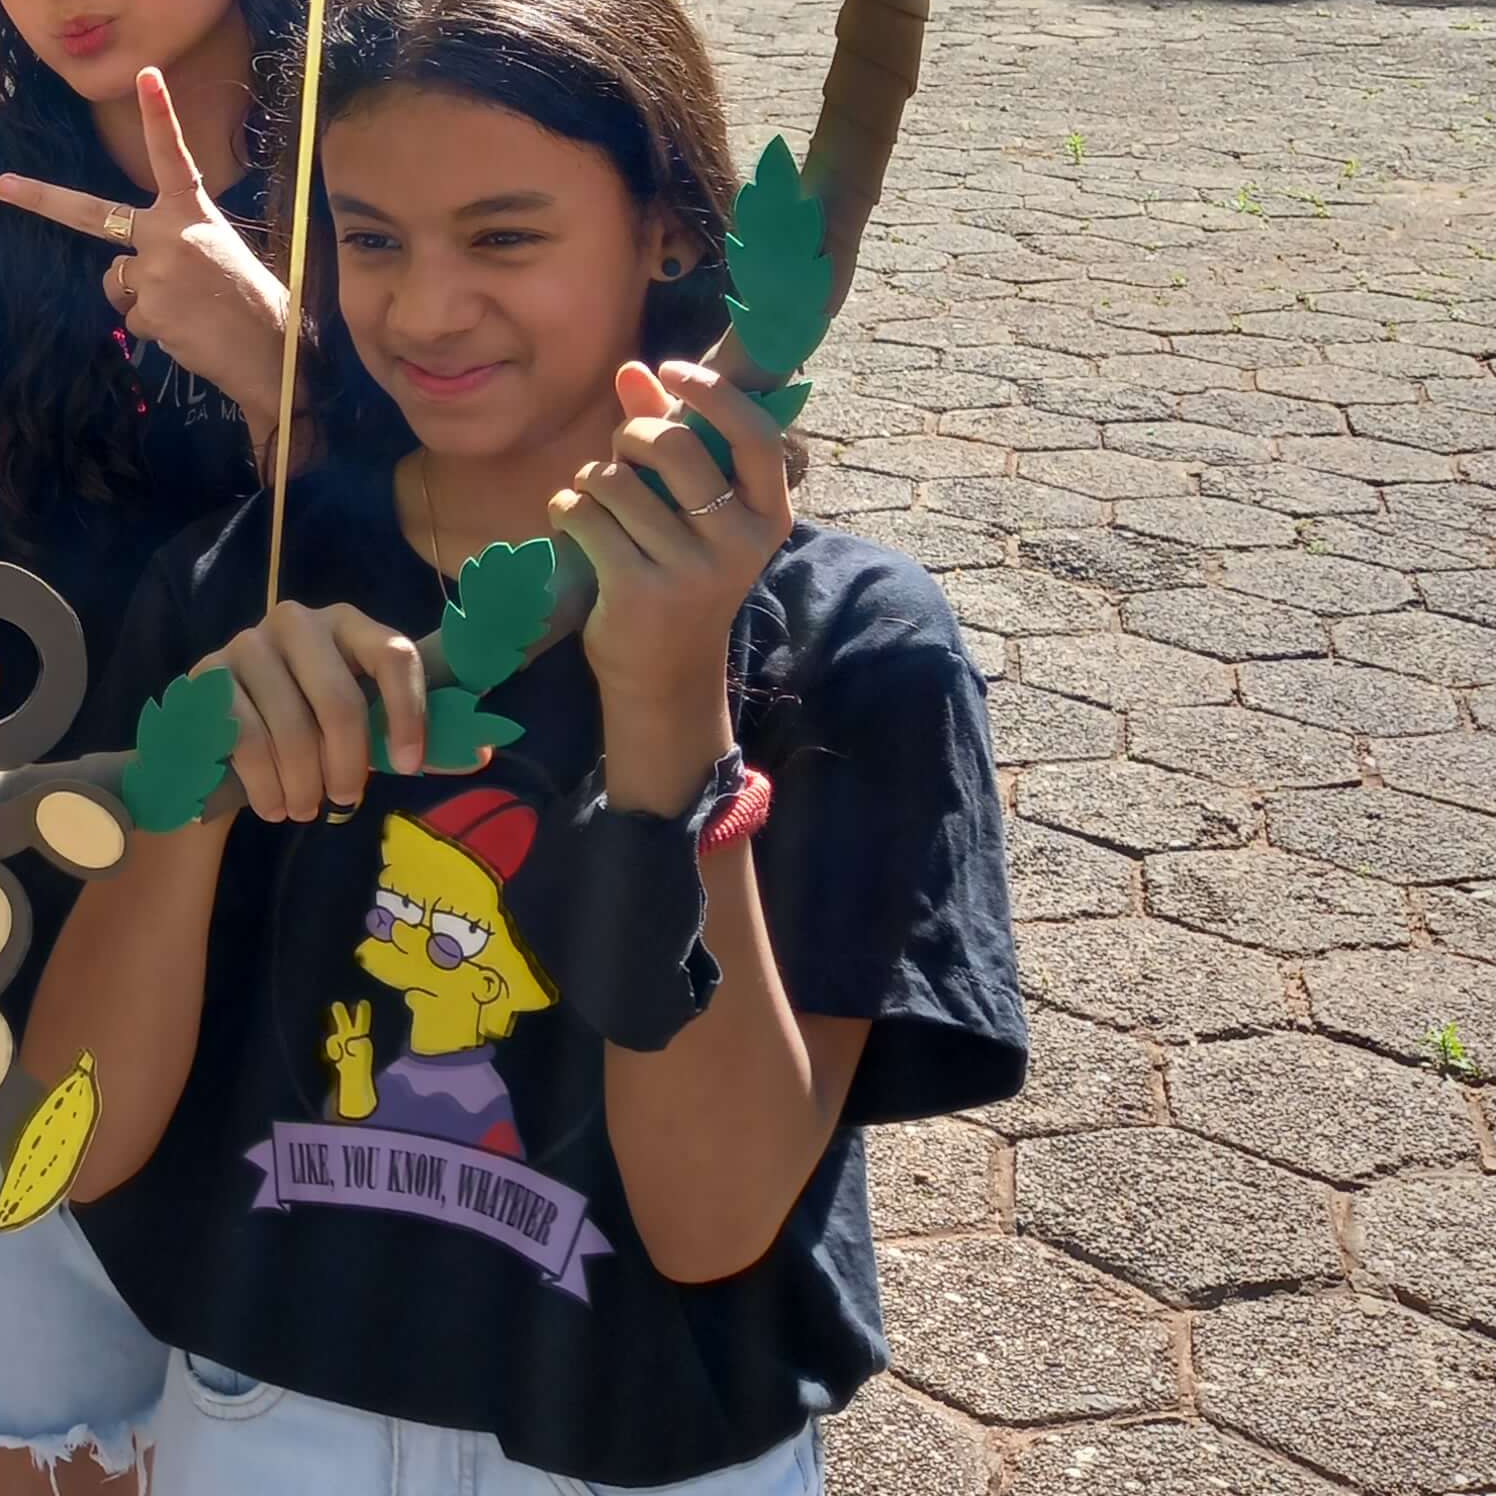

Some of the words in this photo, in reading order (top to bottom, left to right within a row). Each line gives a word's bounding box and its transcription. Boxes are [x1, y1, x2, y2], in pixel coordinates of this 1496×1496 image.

[289, 1142, 336, 1192] LIKE,
[342, 1145, 381, 1190] YOU
[387, 1149, 448, 1208] KNOW,
[457, 1163, 559, 1246] WHATEVER
